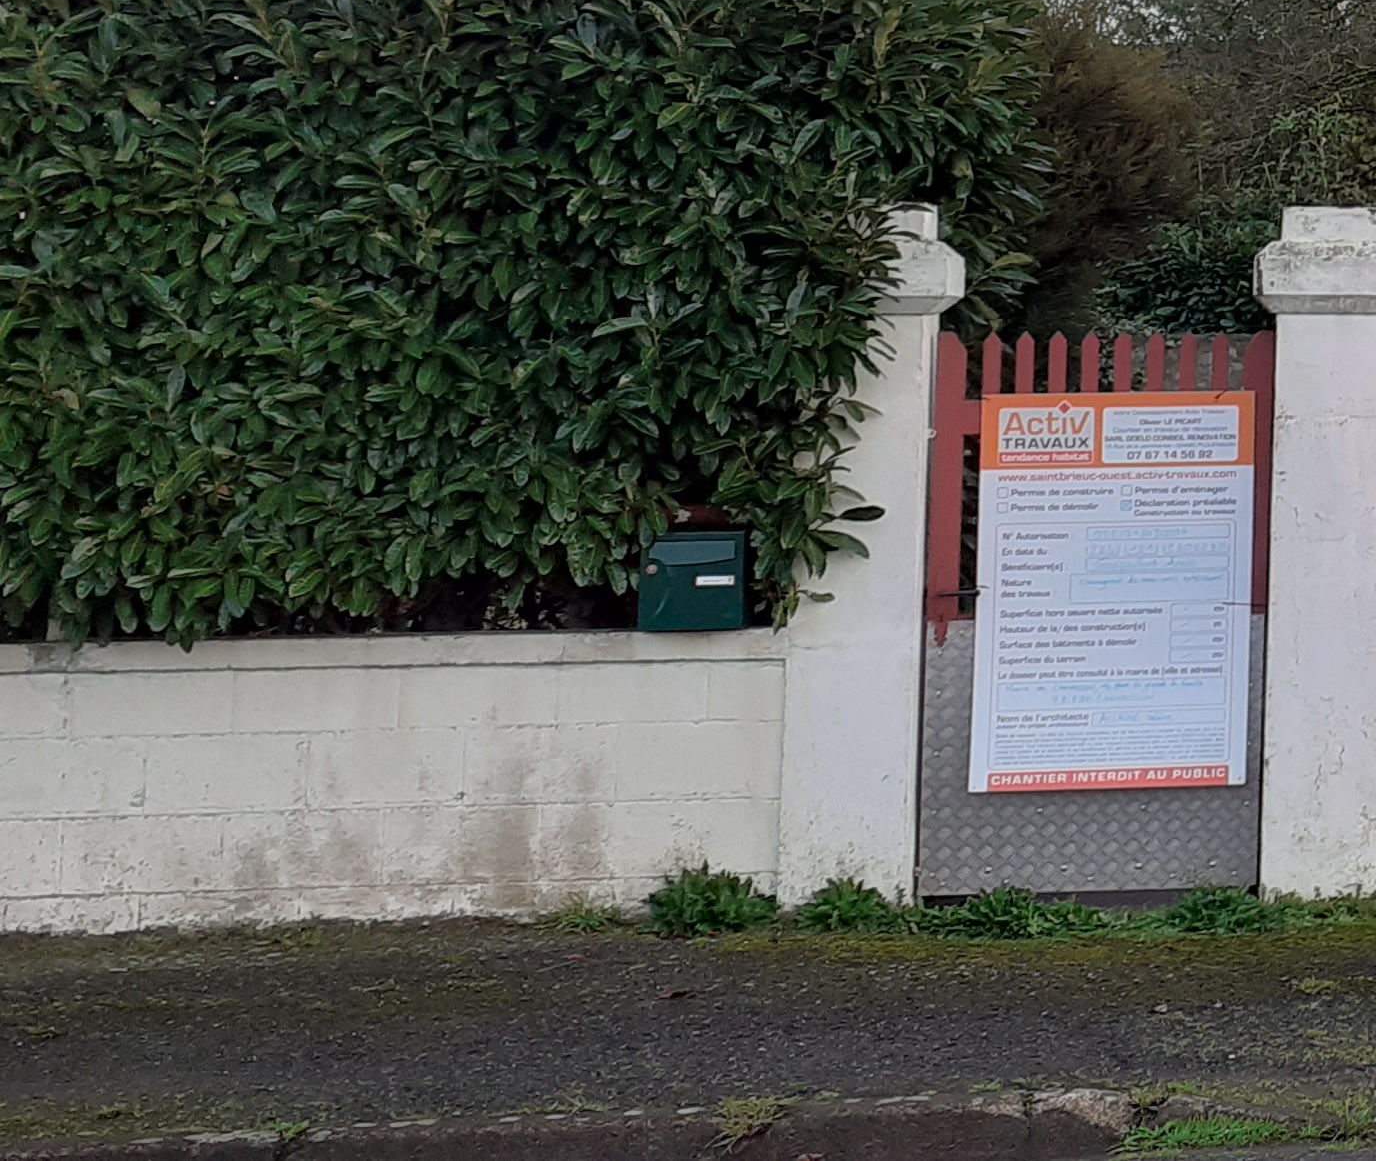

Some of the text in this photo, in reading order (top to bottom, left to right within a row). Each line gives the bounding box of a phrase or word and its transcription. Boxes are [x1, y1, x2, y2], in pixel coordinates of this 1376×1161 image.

[1003, 411, 1090, 435] Activ
[1003, 437, 1089, 449] TRAVAUX
[1001, 452, 1089, 463] tendance habitat
[1127, 451, 1141, 460] 07
[1164, 451, 1177, 459] 14
[998, 470, 1237, 482] www.saintbrieuc-ouest.activ-travaux.com
[1011, 487, 1113, 496] Permis de construire
[1135, 485, 1229, 496] Permis d'aménager
[1011, 502, 1099, 512] Permis de démolir
[1134, 498, 1236, 508] Déclaration préalable
[1134, 509, 1189, 517] Construction
[1016, 532, 1069, 540] Autorisation
[1002, 547, 1047, 556] En date du
[1001, 578, 1032, 587] Nature
[1001, 590, 1019, 598] des
[1000, 609, 1043, 620] Superficie
[1045, 609, 1065, 617] hors
[1000, 625, 1035, 634] Hauteur
[1038, 624, 1048, 633] de
[1081, 622, 1147, 632] construction(s)
[999, 640, 1032, 649] Surface
[1035, 640, 1050, 648] des
[998, 656, 1042, 666] Superficie
[1044, 656, 1054, 664] du
[998, 671, 1007, 680] Le
[1009, 670, 1037, 679] dossier
[1151, 667, 1160, 675] de
[996, 712, 1089, 723] Nom de l'architecte
[991, 767, 1226, 786] CHANTIER INTERDIT AU PUBLIC
